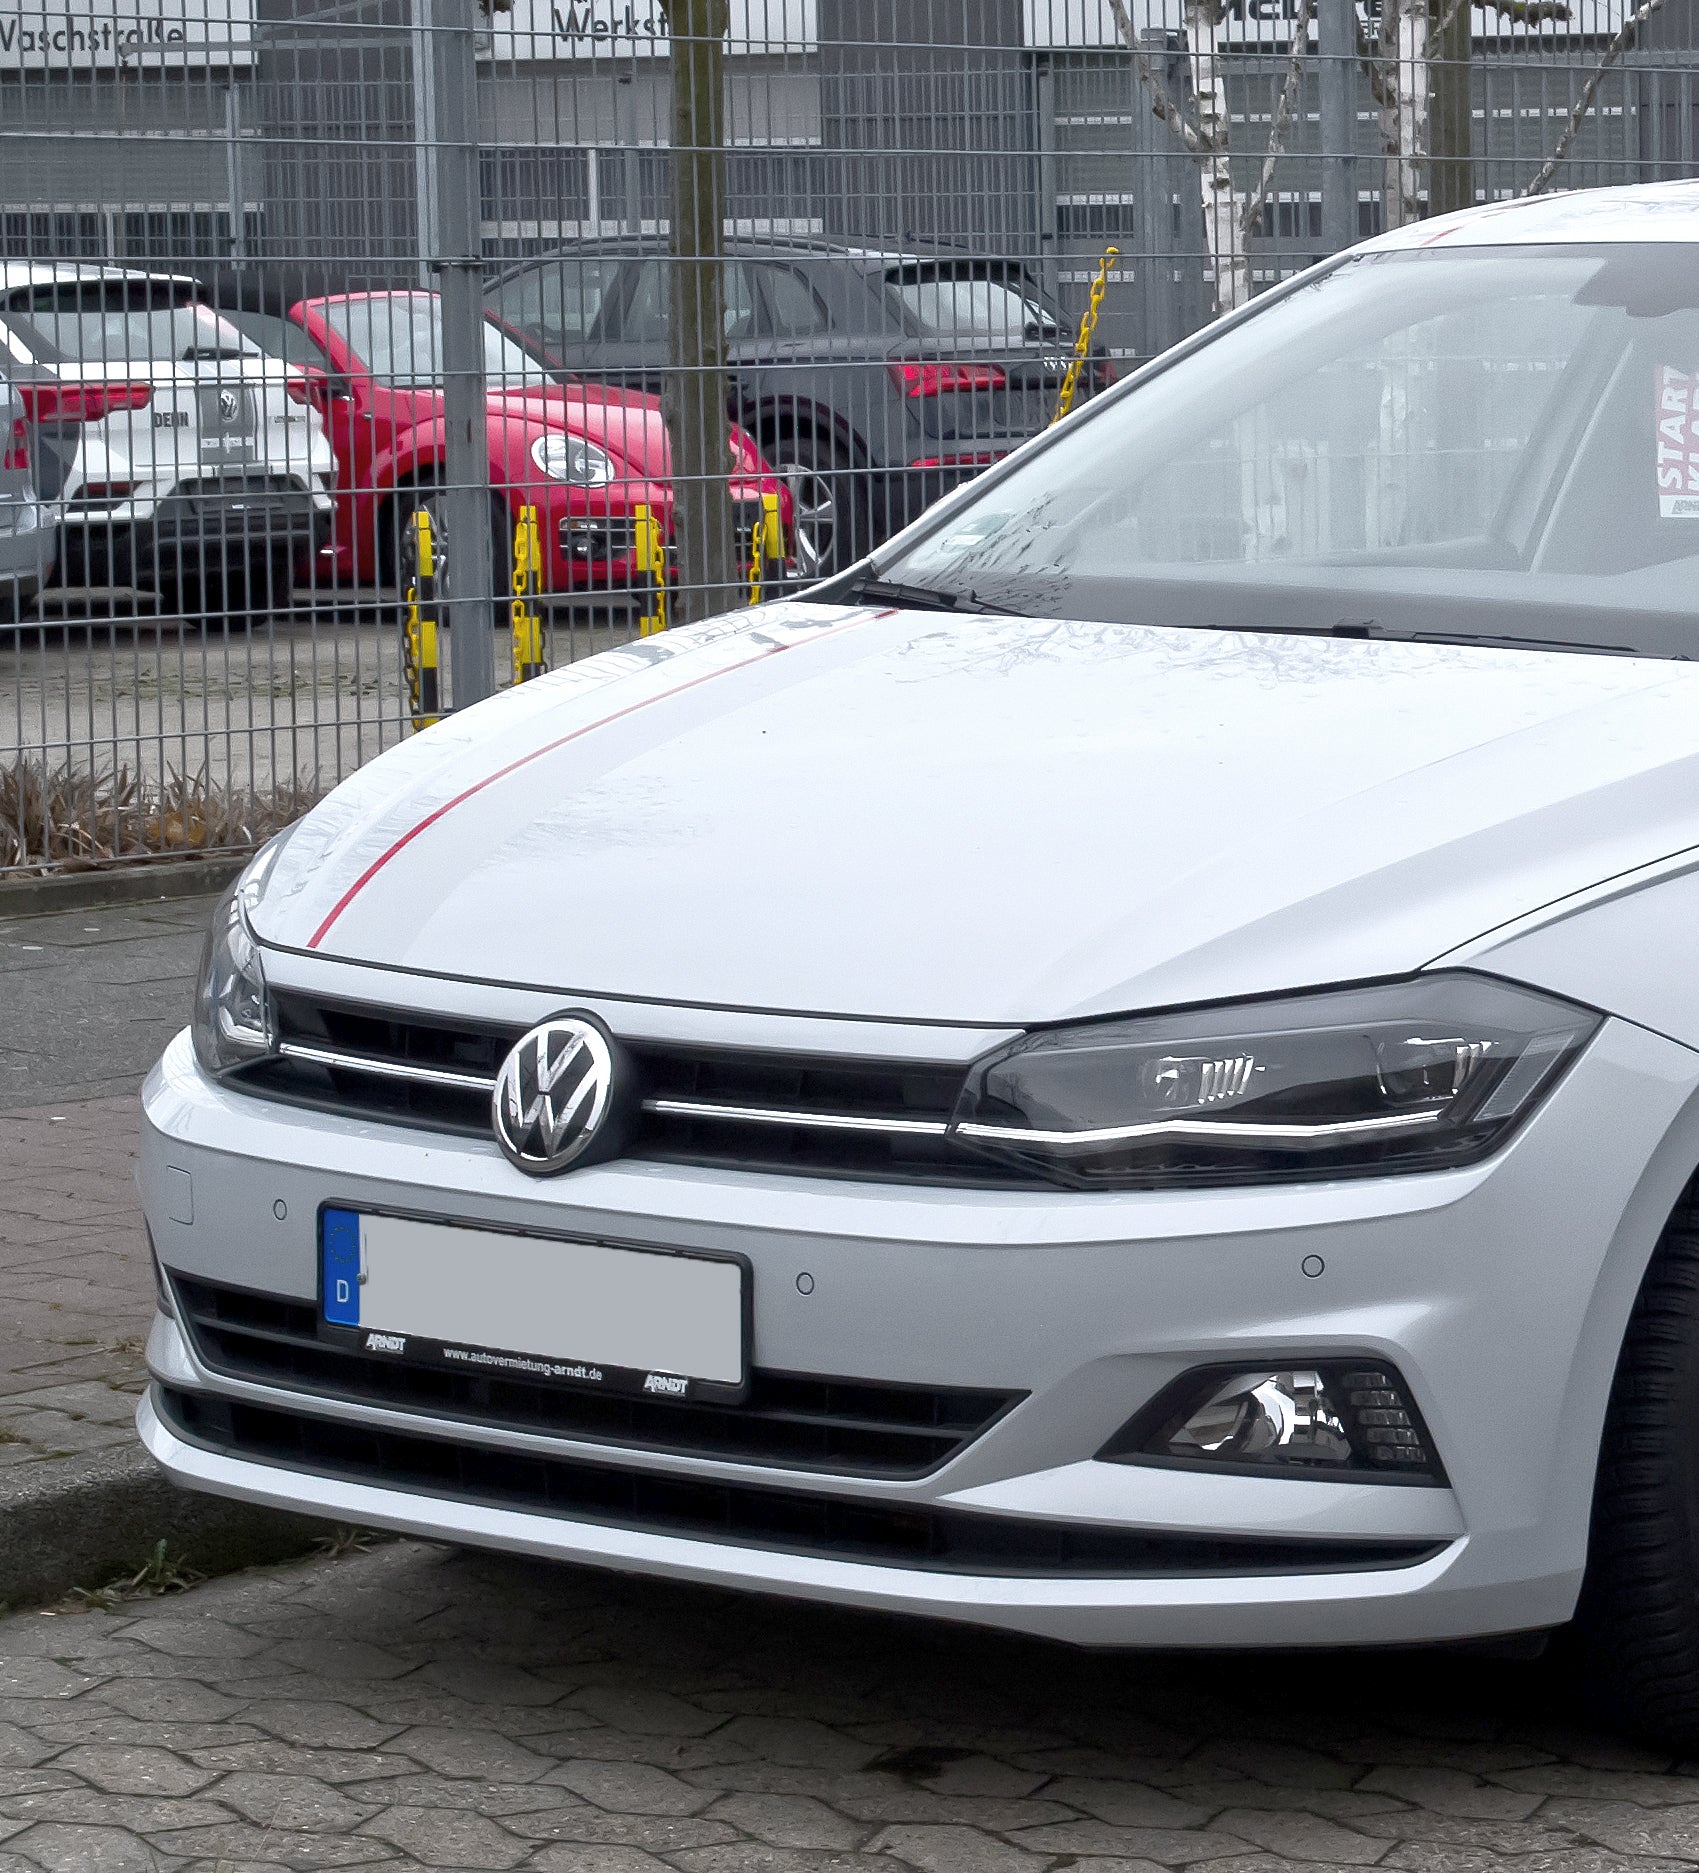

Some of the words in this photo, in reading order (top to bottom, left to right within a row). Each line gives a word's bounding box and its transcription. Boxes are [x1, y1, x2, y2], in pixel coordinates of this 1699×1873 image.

[554, 4, 669, 42] Werkst
[1657, 364, 1690, 491] START
[336, 1279, 349, 1303] D
[366, 1332, 407, 1353] ARNDT
[442, 1347, 603, 1381] www.autovermietung-arndt.de
[644, 1373, 688, 1394] ARNDT
